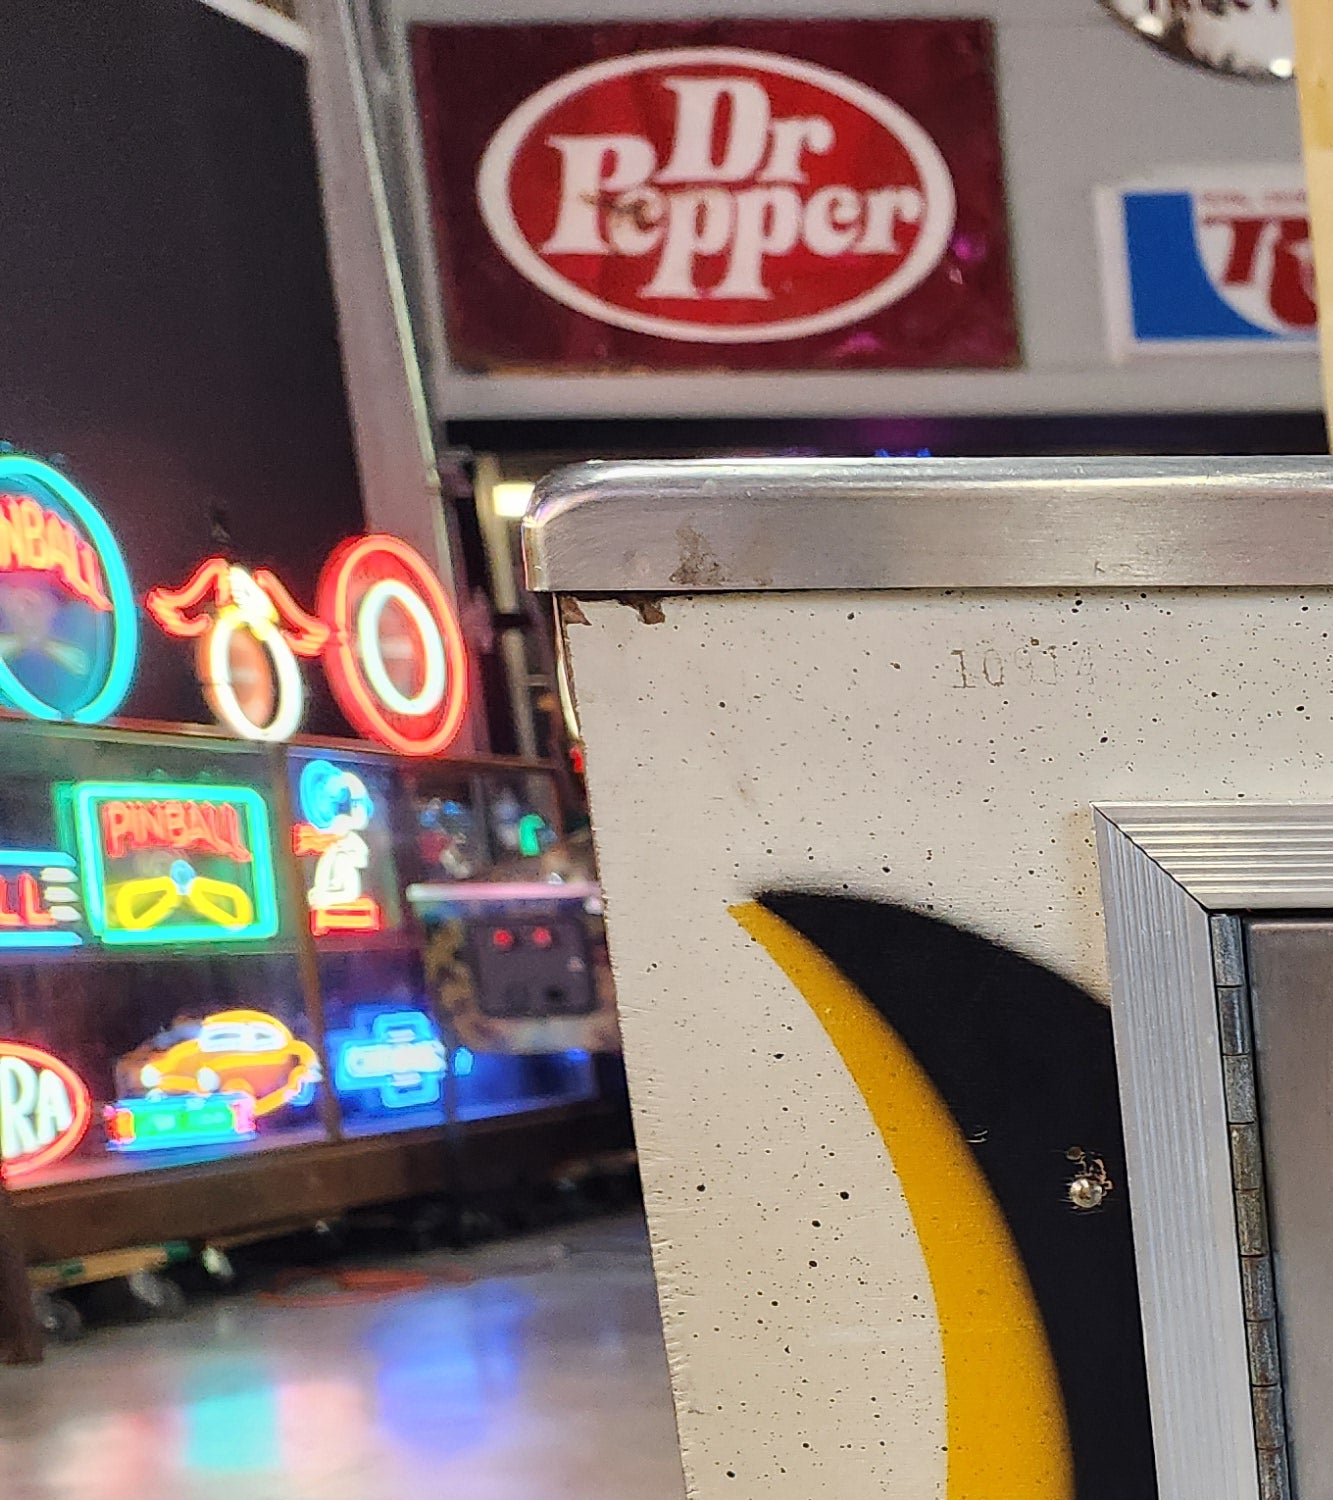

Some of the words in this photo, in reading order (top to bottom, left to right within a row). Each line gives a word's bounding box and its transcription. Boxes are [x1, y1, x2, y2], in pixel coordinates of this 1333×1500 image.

[654, 75, 835, 185] Dr
[540, 133, 923, 299] Pepper
[101, 799, 253, 862] PINBALL
